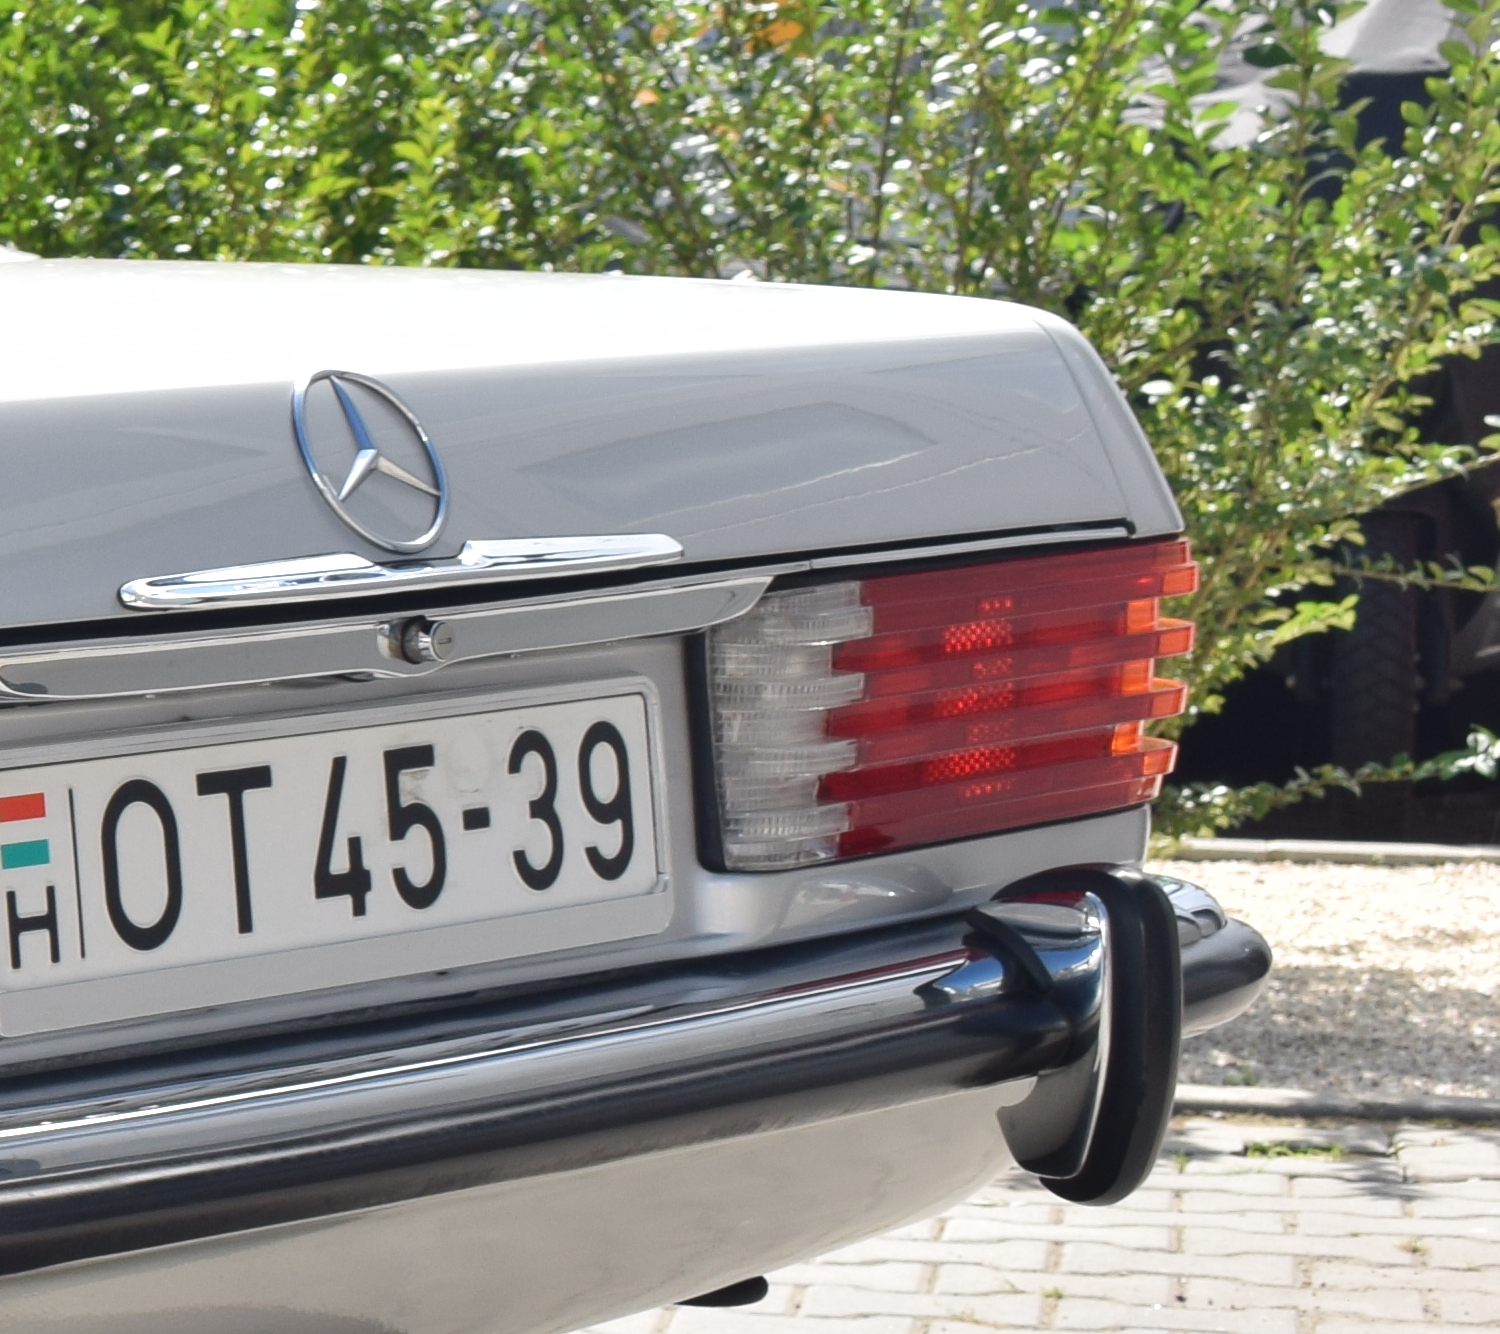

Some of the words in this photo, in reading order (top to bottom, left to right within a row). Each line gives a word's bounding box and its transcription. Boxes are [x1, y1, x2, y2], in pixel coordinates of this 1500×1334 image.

[101, 765, 272, 951] OT
[314, 720, 634, 917] 45-39
[6, 885, 60, 970] H
